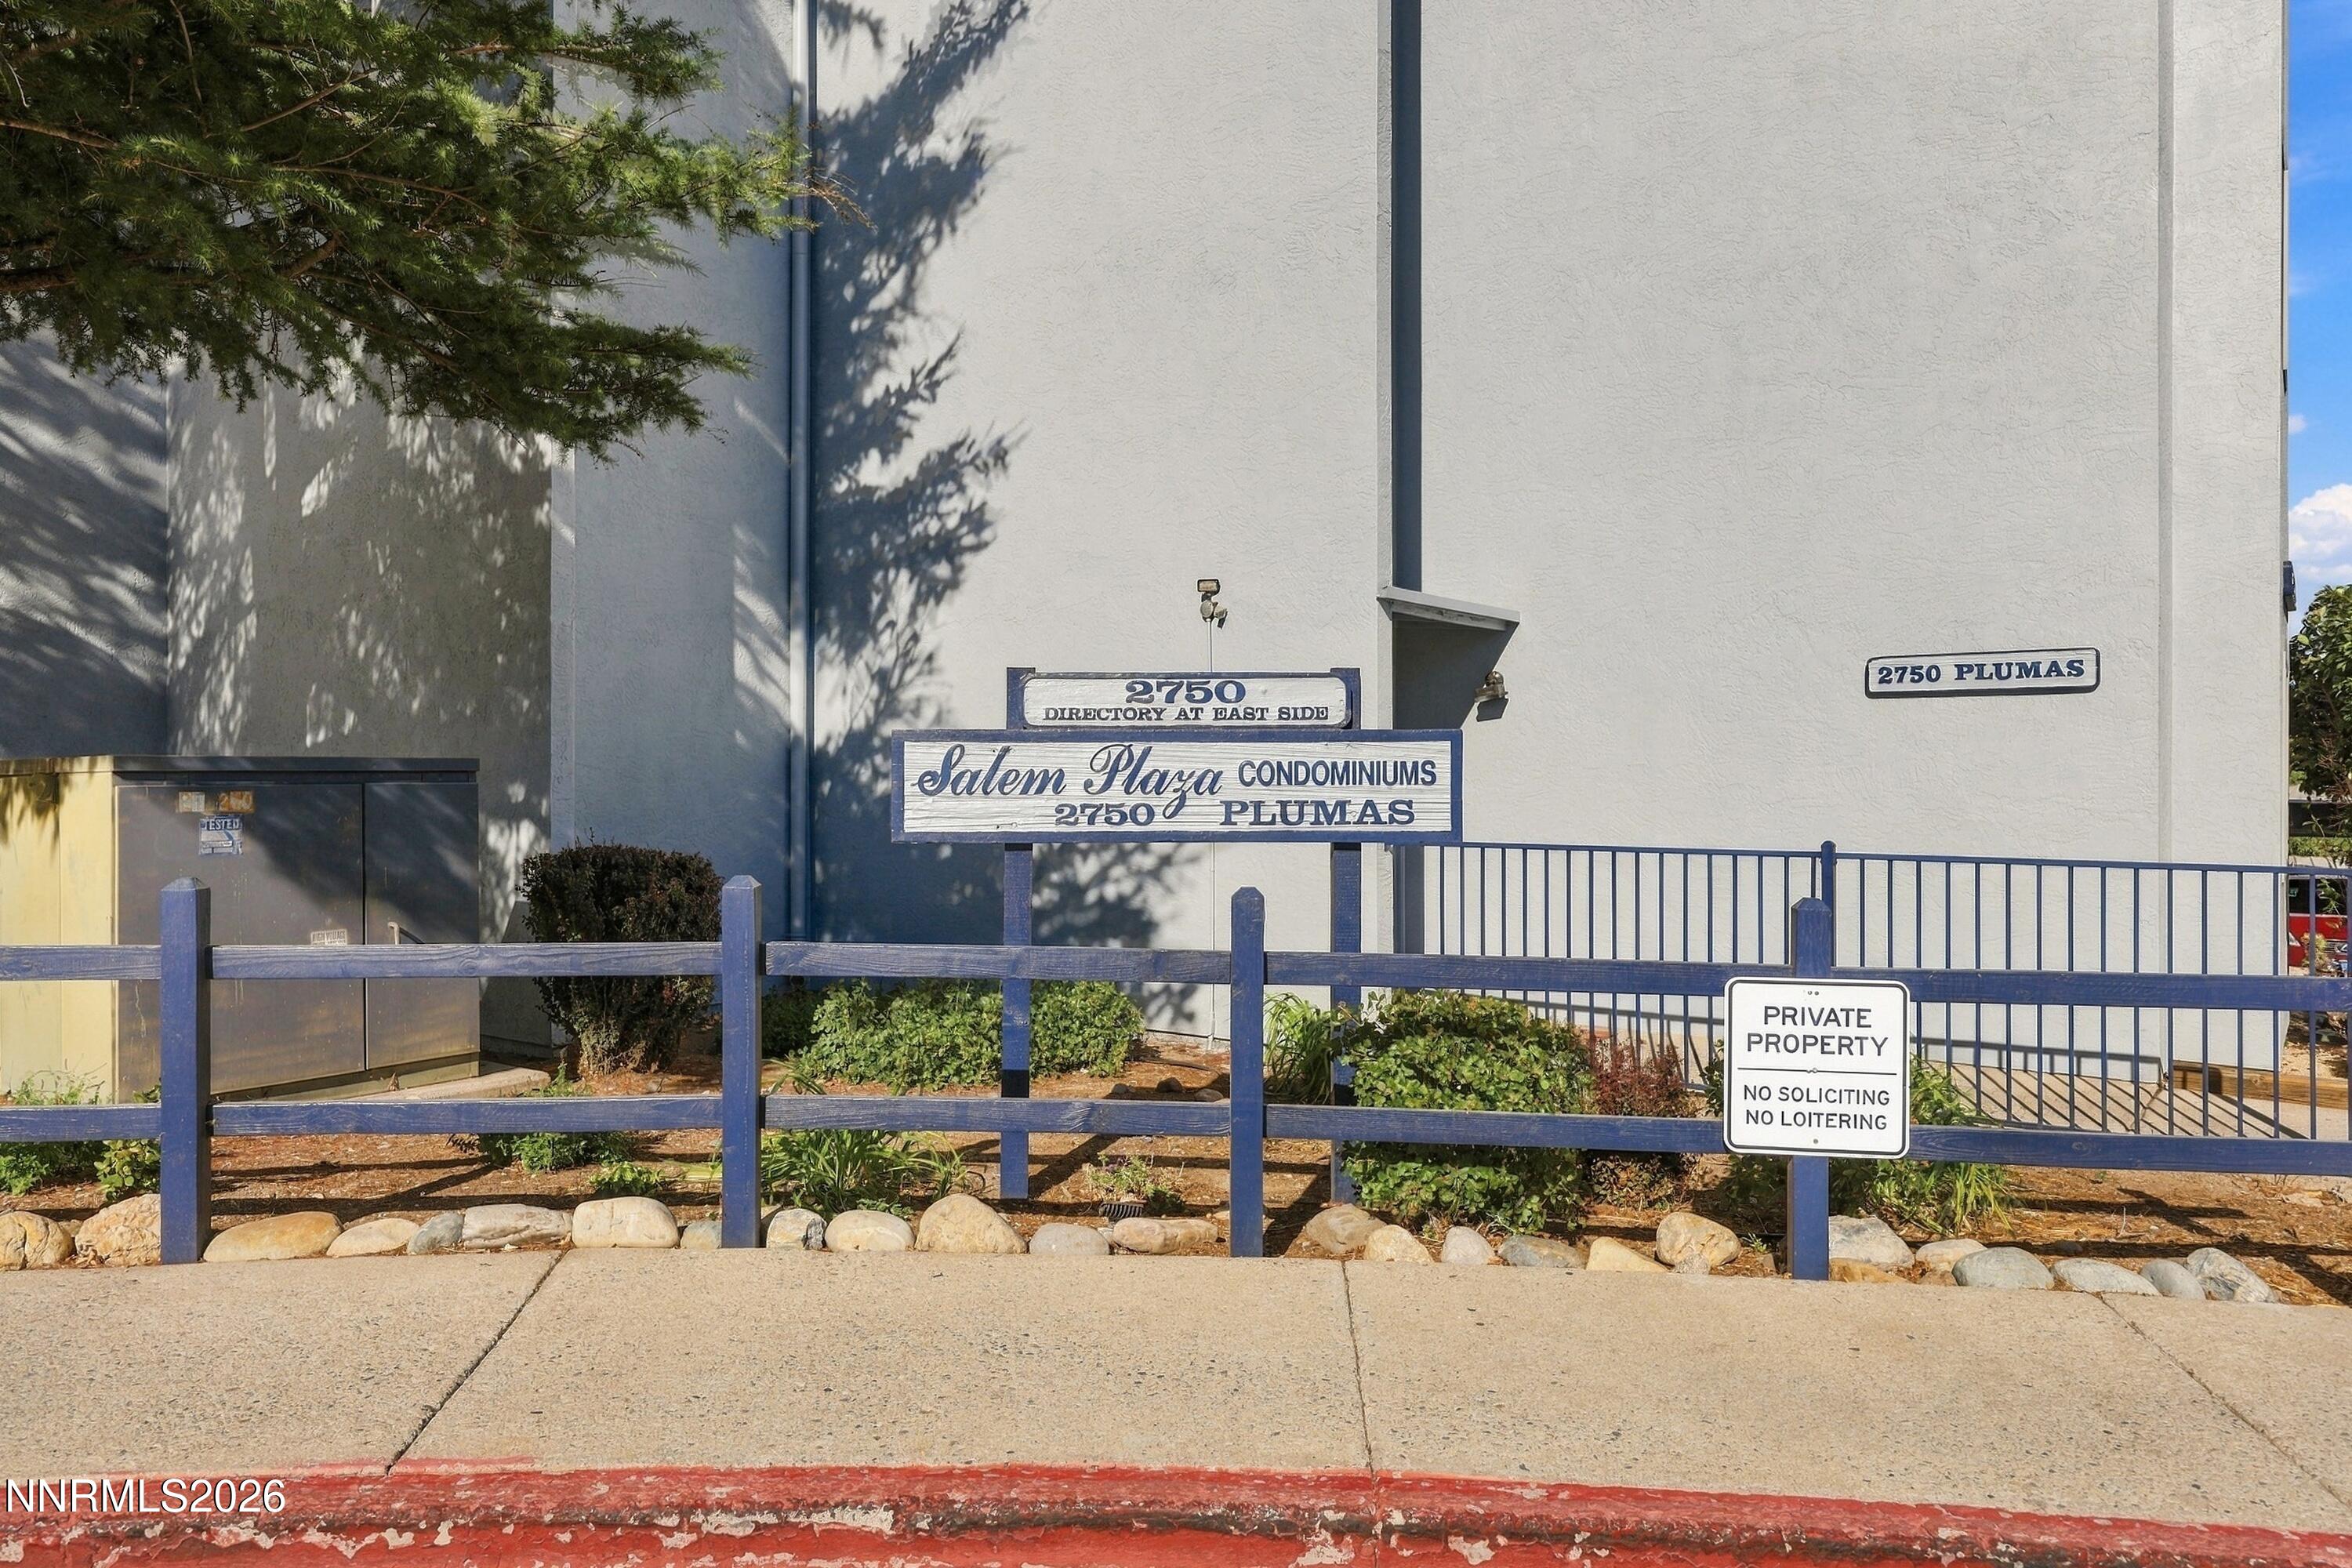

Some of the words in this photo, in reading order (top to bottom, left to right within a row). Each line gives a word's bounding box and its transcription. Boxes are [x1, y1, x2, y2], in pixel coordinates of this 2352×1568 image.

[1878, 664, 1942, 685] 2750
[1954, 659, 2085, 681] PLUMAS
[1125, 680, 1247, 705] 2750
[1044, 707, 1167, 721] DIRECTORY
[1174, 707, 1204, 721] AT
[1213, 706, 1269, 721] EAST
[1276, 706, 1329, 721] SIDE
[916, 744, 1067, 797] Salem
[1083, 744, 1224, 820] Plaza
[1238, 760, 1437, 787] CONDOMINIUMS
[203, 818, 239, 830] TESTED
[1054, 802, 1156, 826] 2750
[1219, 799, 1416, 826] PLUMAS
[1764, 1005, 1871, 1028] PRIVATE
[1747, 1033, 1889, 1057] PROPERTY
[1744, 1084, 1772, 1102] NO
[1778, 1086, 1890, 1106] SOLICITING
[1746, 1109, 1773, 1126] NO
[1781, 1110, 1887, 1131] LOITERING
